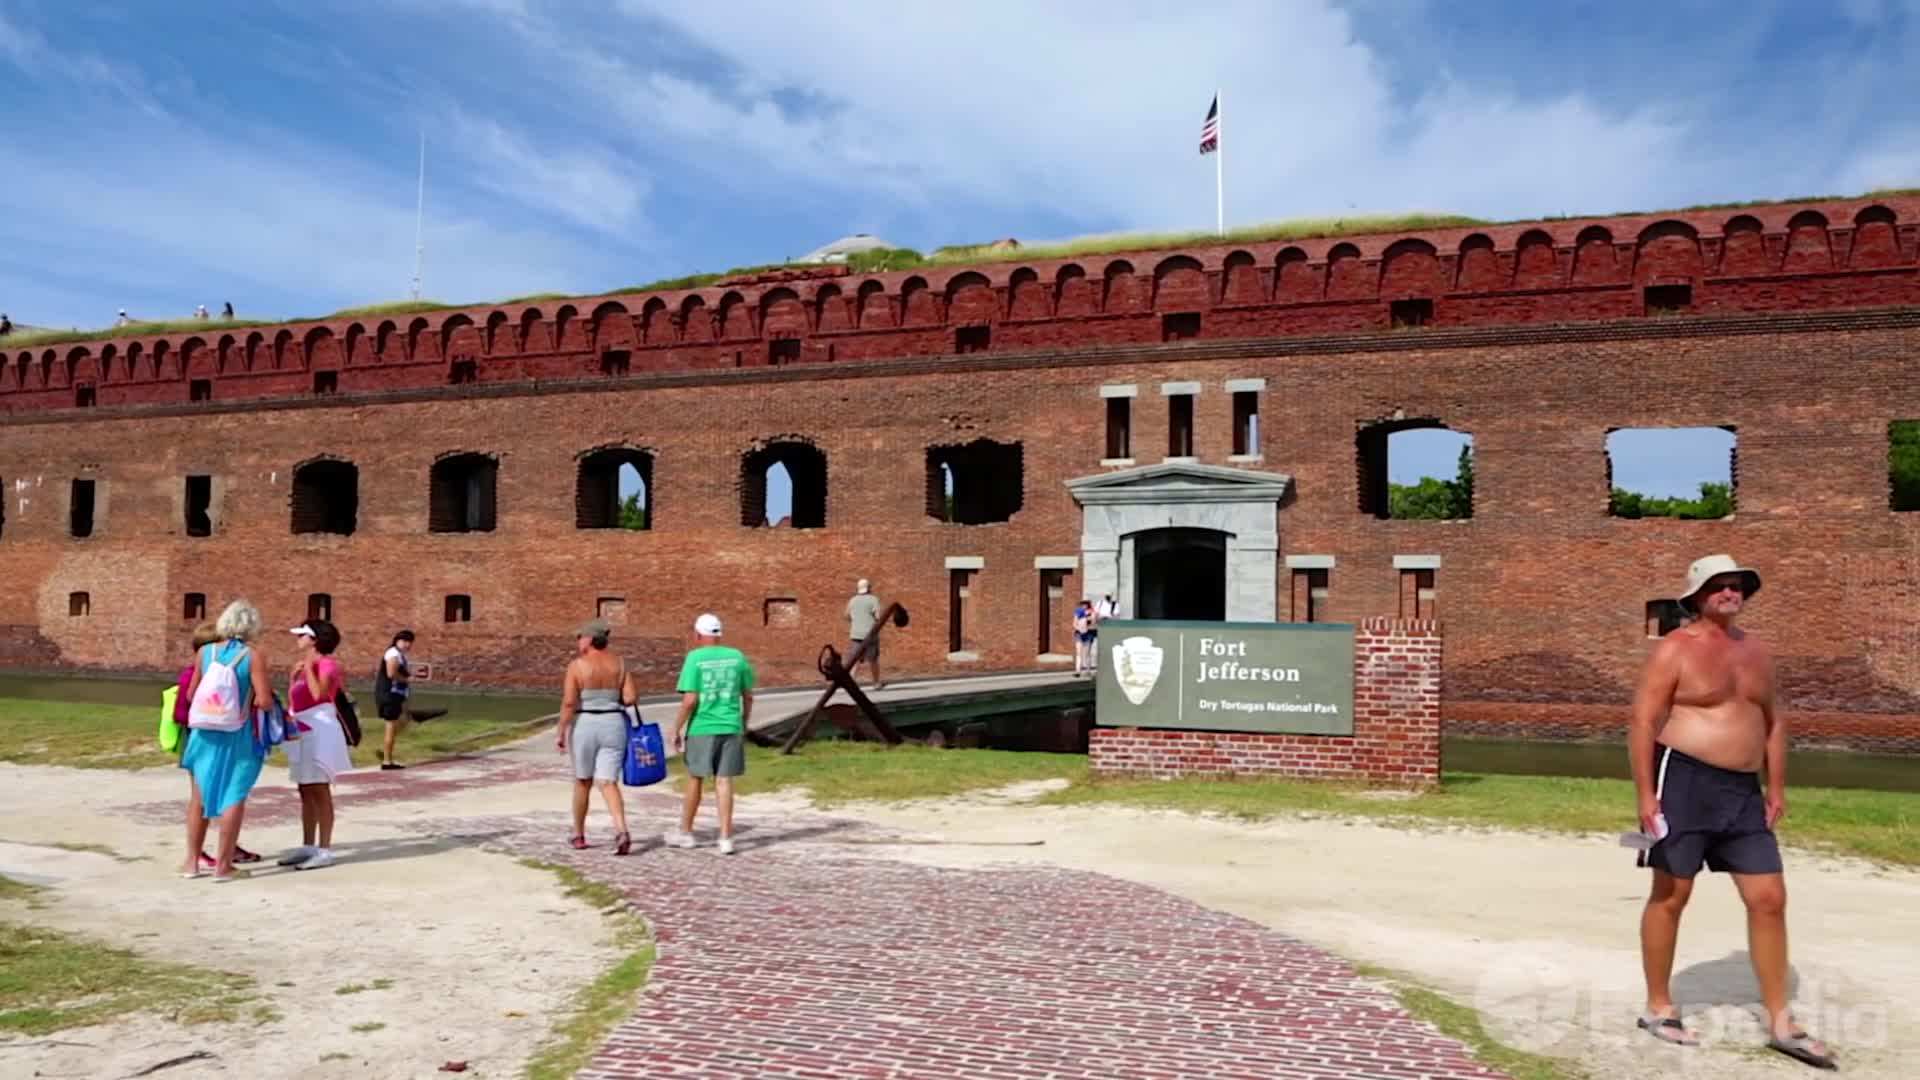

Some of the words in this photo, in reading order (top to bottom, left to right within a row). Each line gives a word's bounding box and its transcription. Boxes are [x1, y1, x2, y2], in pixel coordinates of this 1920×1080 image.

[1199, 638, 1247, 656] Fort
[1197, 661, 1300, 683] Jefferson
[1199, 699, 1218, 712] Dry
[1220, 700, 1265, 713] Tortugas
[1267, 702, 1312, 713] National
[1314, 703, 1338, 714] Park
